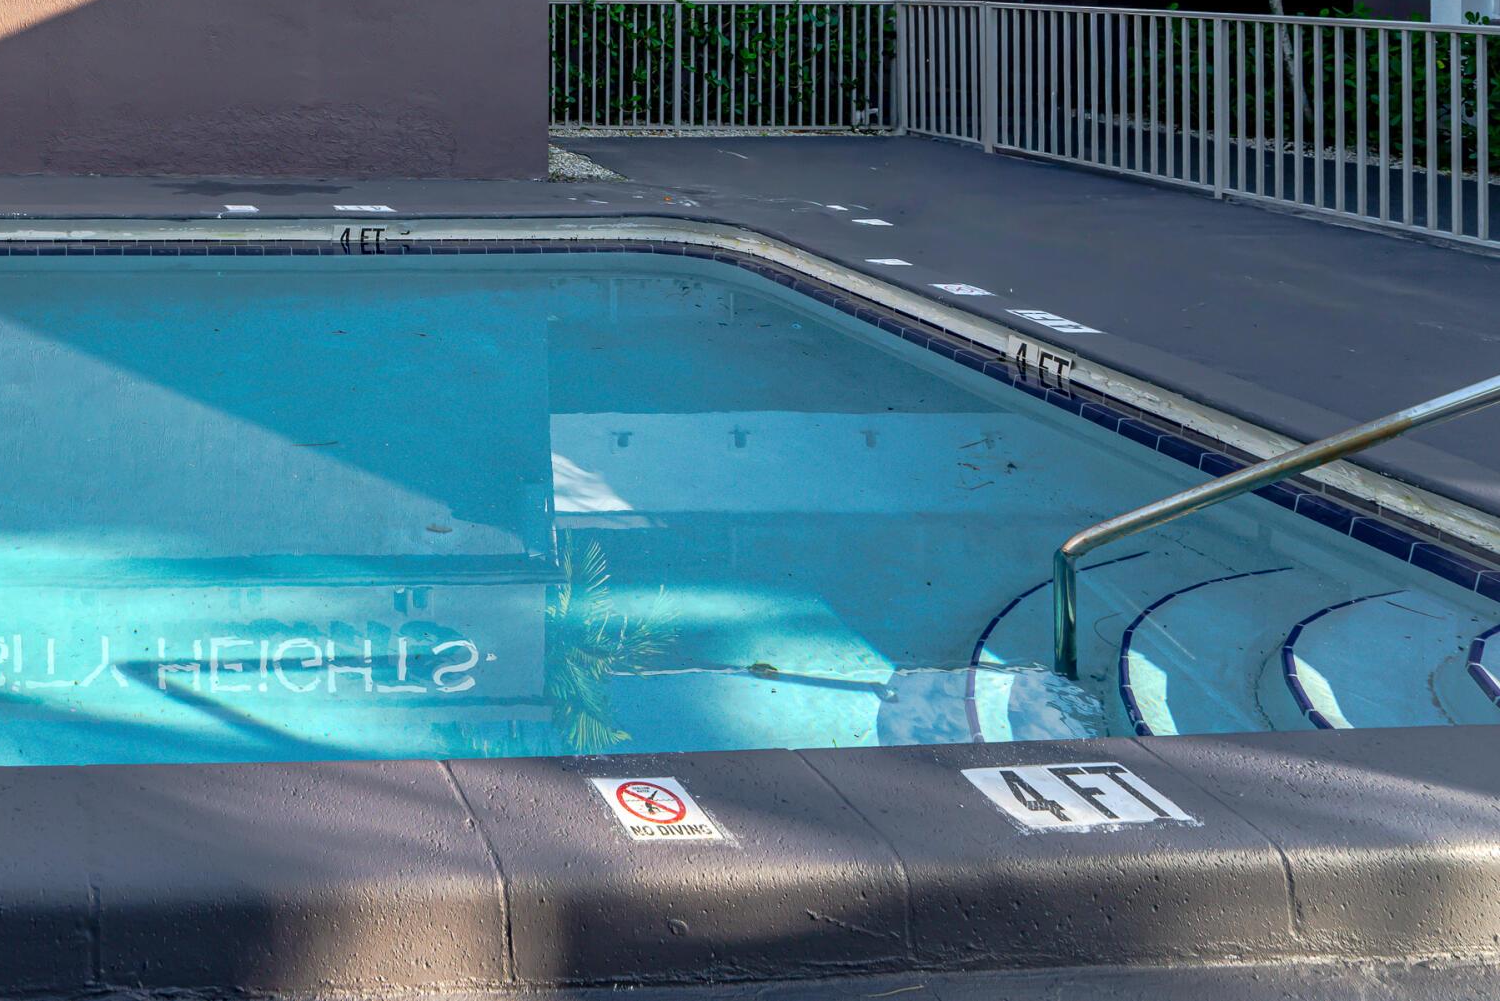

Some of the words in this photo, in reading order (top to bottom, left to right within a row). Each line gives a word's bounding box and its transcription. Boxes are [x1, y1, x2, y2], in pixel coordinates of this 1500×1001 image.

[999, 770, 1072, 822] 4
[1047, 765, 1172, 819] FT
[630, 825, 655, 836] NO
[656, 824, 713, 836] DIVING
